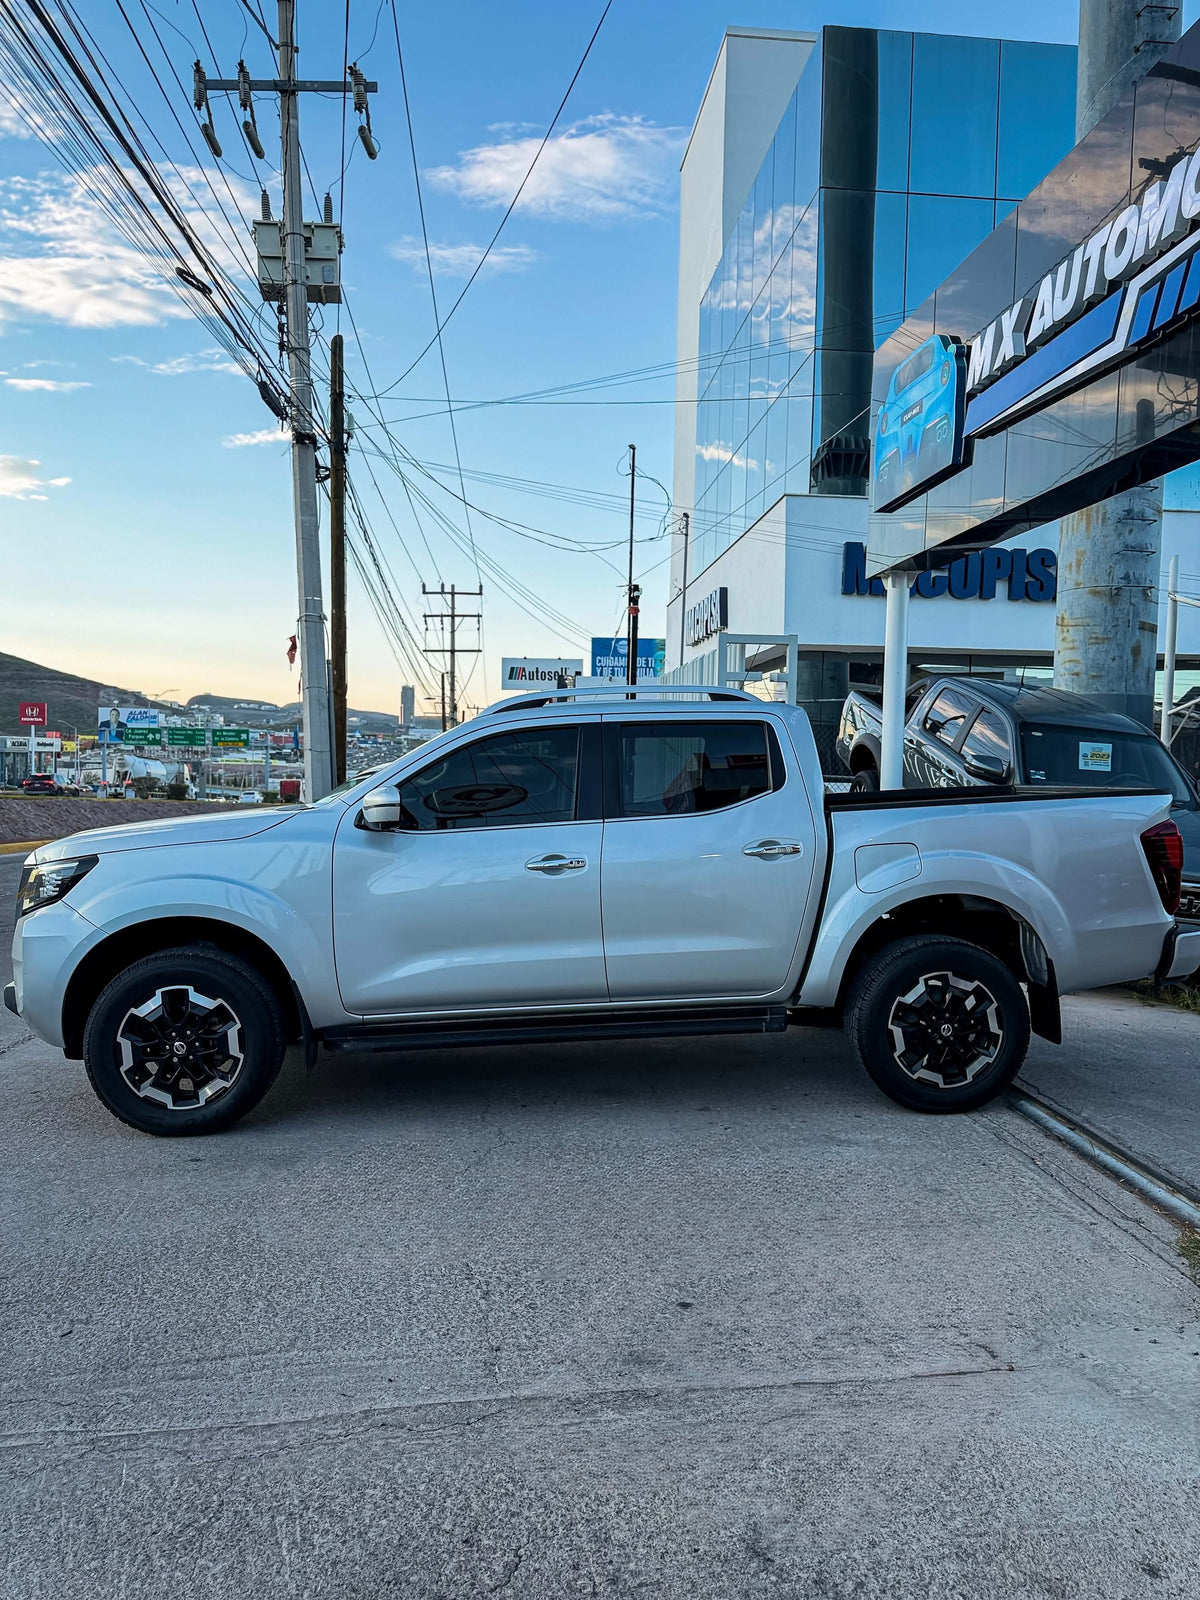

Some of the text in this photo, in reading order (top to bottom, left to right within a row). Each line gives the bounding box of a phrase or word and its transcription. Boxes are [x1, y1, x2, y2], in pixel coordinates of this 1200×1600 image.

[841, 541, 1057, 602] MCOPIS
[596, 667, 602, 677] Y
[603, 667, 613, 677] DE
[614, 667, 624, 677] TU
